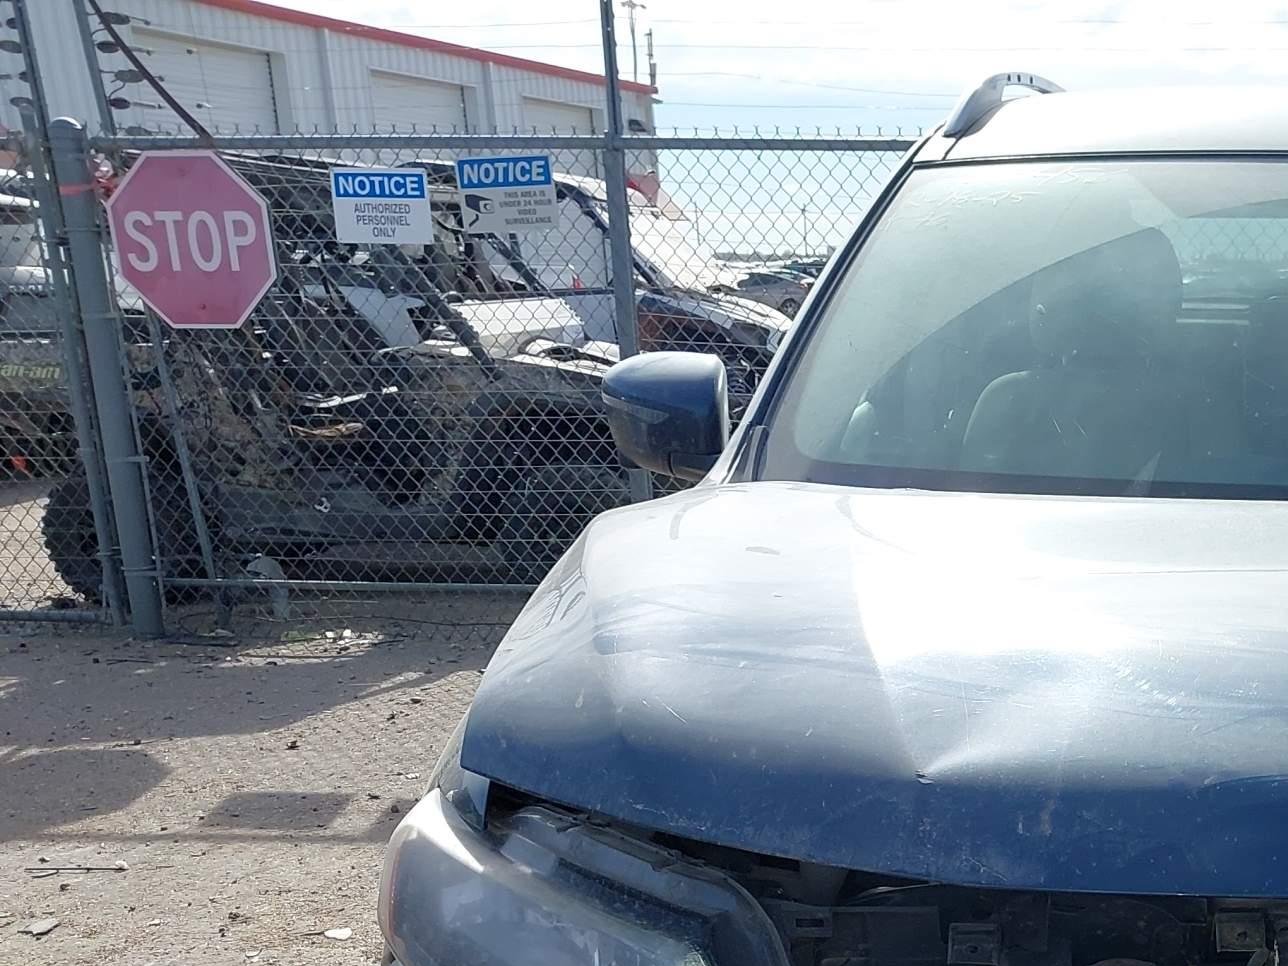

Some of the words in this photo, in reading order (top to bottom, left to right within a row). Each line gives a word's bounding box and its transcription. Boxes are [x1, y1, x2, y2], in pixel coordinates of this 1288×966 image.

[463, 160, 546, 185] NOTICE
[338, 176, 421, 195] NOTICE
[354, 203, 411, 214] AUTHORIZED
[499, 200, 521, 208] UNDER
[356, 215, 411, 226] PERSONNEL
[505, 216, 552, 225] SURVEILLANCE
[372, 227, 397, 238] ONLY
[123, 210, 257, 272] STOP
[0, 364, 61, 379] an-am
